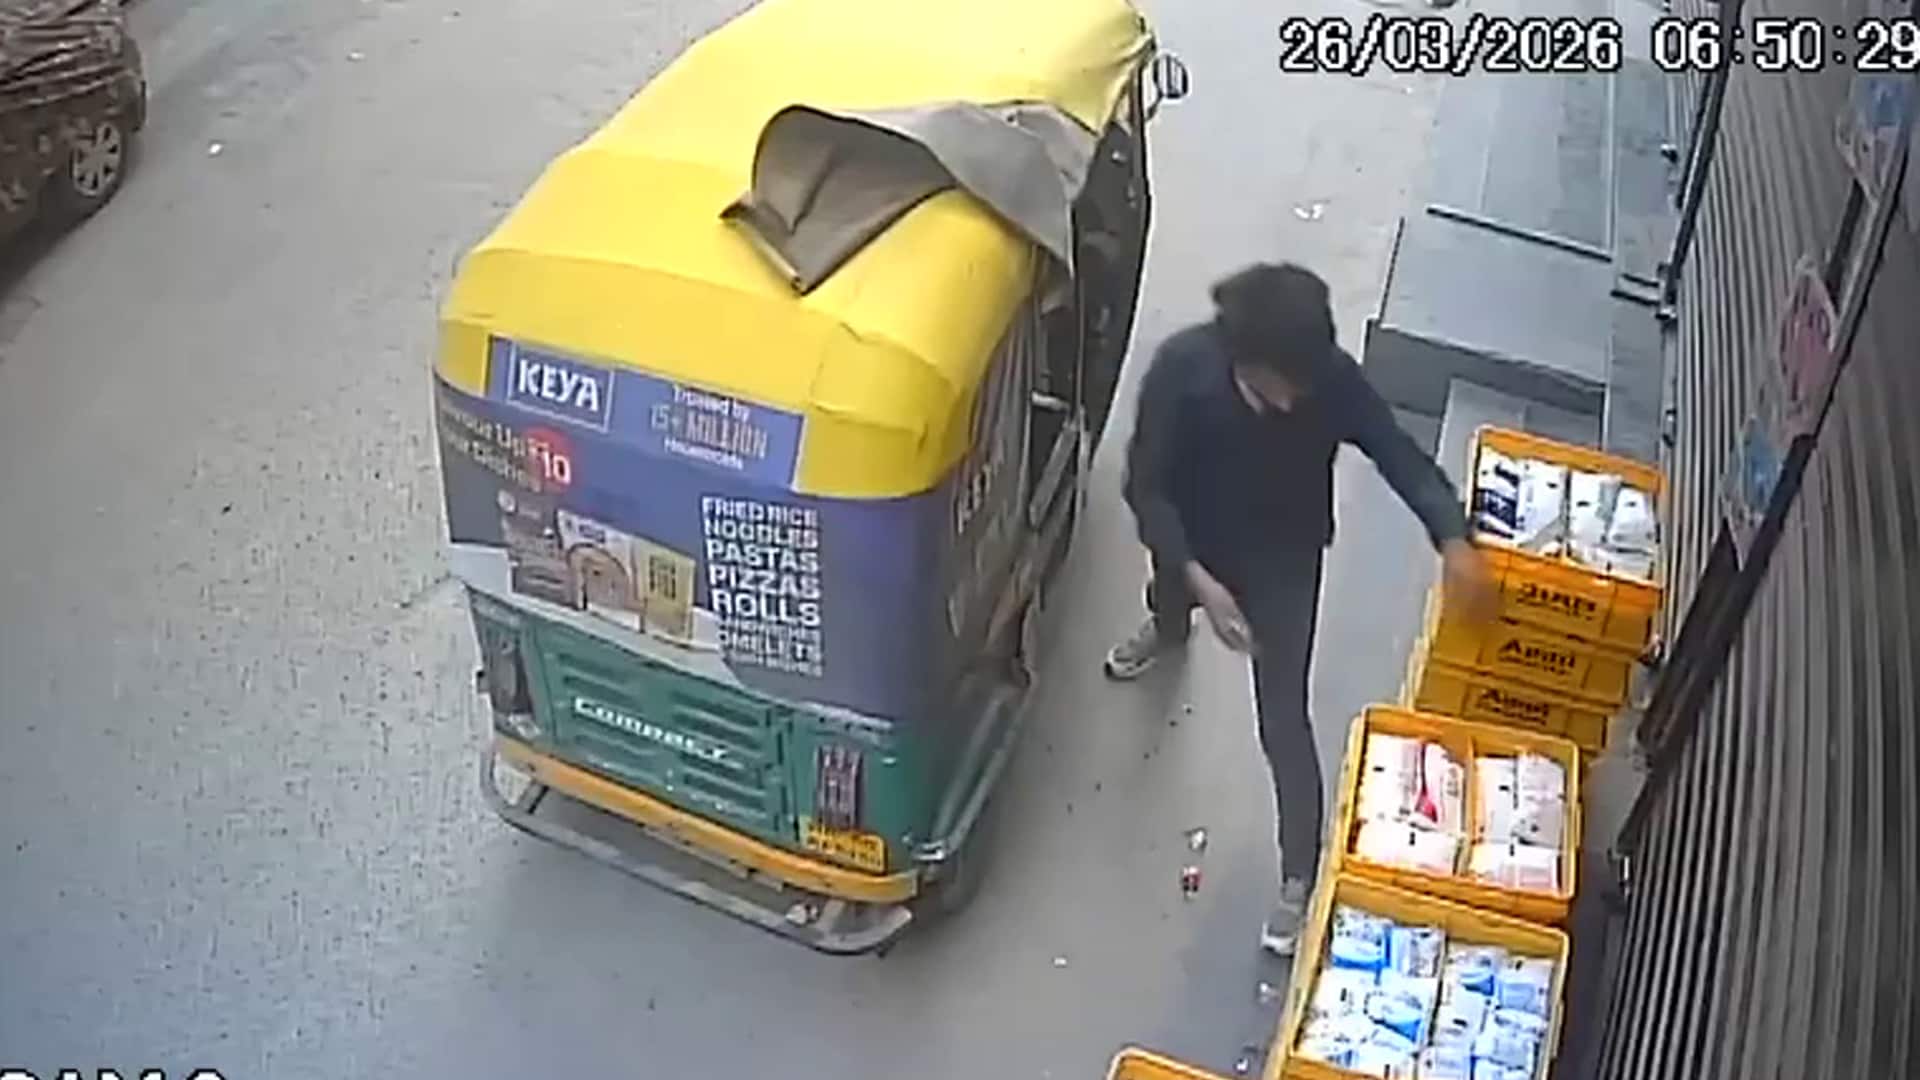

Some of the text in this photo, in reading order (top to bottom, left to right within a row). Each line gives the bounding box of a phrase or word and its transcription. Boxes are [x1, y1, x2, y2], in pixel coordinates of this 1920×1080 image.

[519, 359, 598, 411] KEYA
[702, 495, 819, 527] FRIED RICE
[704, 517, 819, 549] NOODLES
[706, 538, 819, 574] PASTAS
[709, 563, 821, 600] PIZZAS
[711, 588, 822, 628] ROLLS
